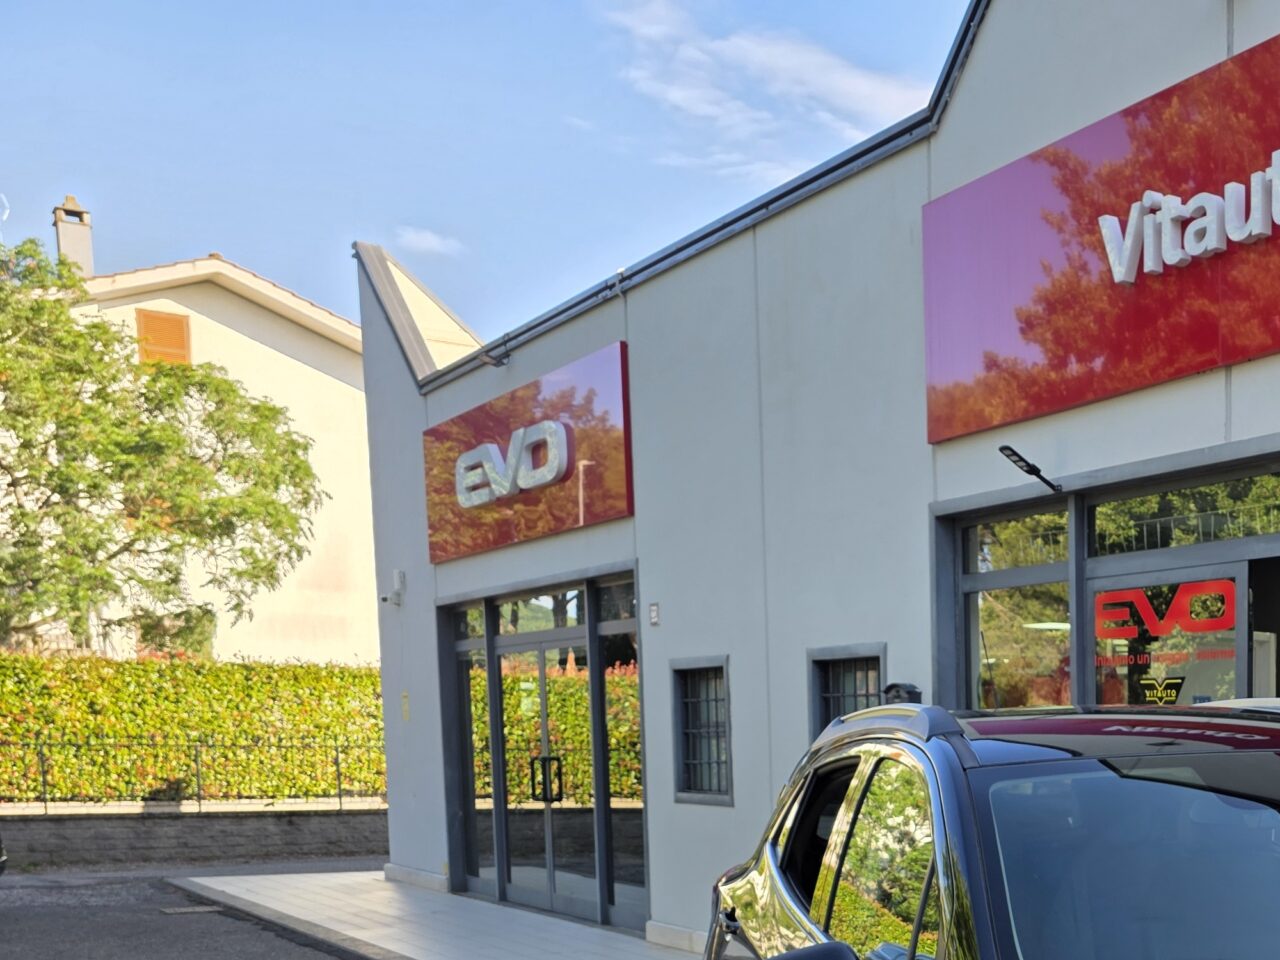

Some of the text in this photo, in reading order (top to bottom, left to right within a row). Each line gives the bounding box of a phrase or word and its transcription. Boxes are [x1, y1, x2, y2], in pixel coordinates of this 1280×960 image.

[455, 420, 567, 508] EVO
[1095, 579, 1236, 639] EVO
[1145, 689, 1176, 697] VITAUTO
